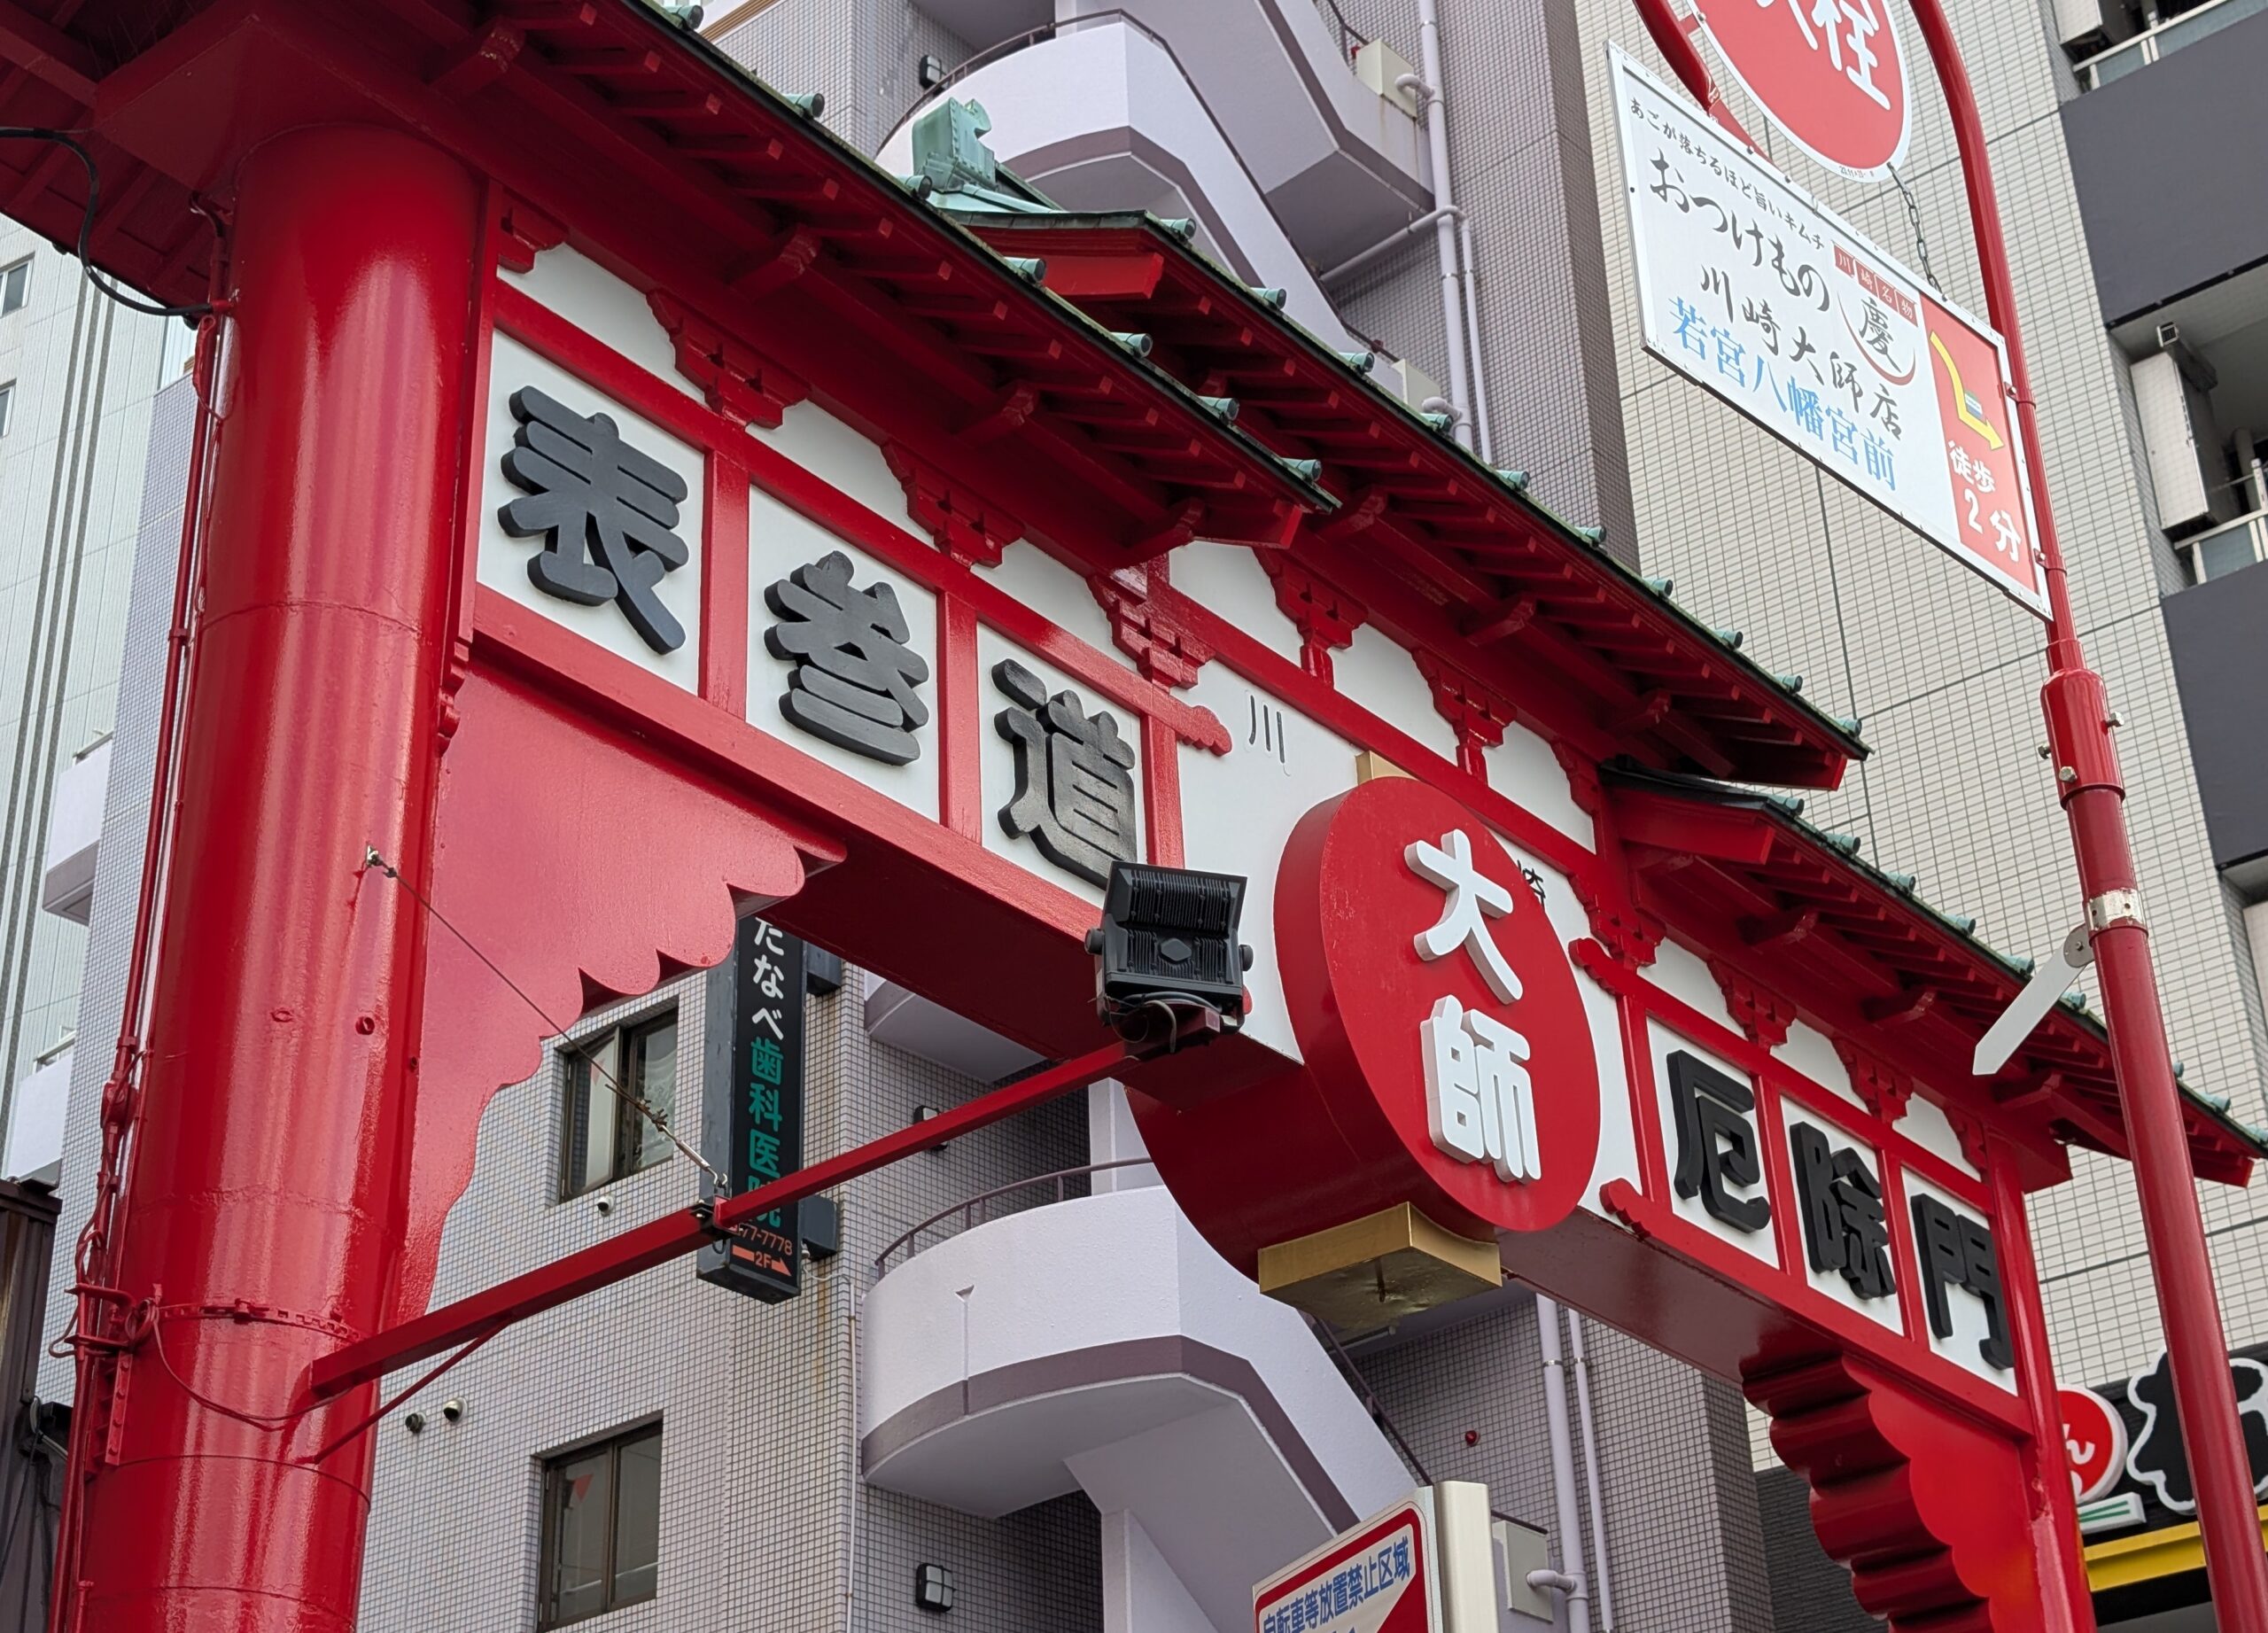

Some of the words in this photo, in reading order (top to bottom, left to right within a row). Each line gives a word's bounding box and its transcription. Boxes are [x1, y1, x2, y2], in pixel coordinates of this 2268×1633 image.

[1630, 97, 1824, 250] あごが落ちるほど旨いキムチ
[1650, 147, 1829, 312] おつけもの
[1700, 264, 1902, 441] 川崎大師店
[1838, 253, 1914, 320] 川崎名物
[1859, 296, 1902, 373] 慶
[1668, 296, 1896, 492] 若宮八幡宮前
[1948, 440, 1995, 493] 徒歩
[1964, 488, 2022, 563] 2分
[497, 385, 1138, 890] 表参道
[1404, 828, 1542, 1184] 大師
[734, 1223, 793, 1256] 77-7778
[755, 1250, 772, 1268] 2F
[1666, 1049, 2015, 1371] 厄除門
